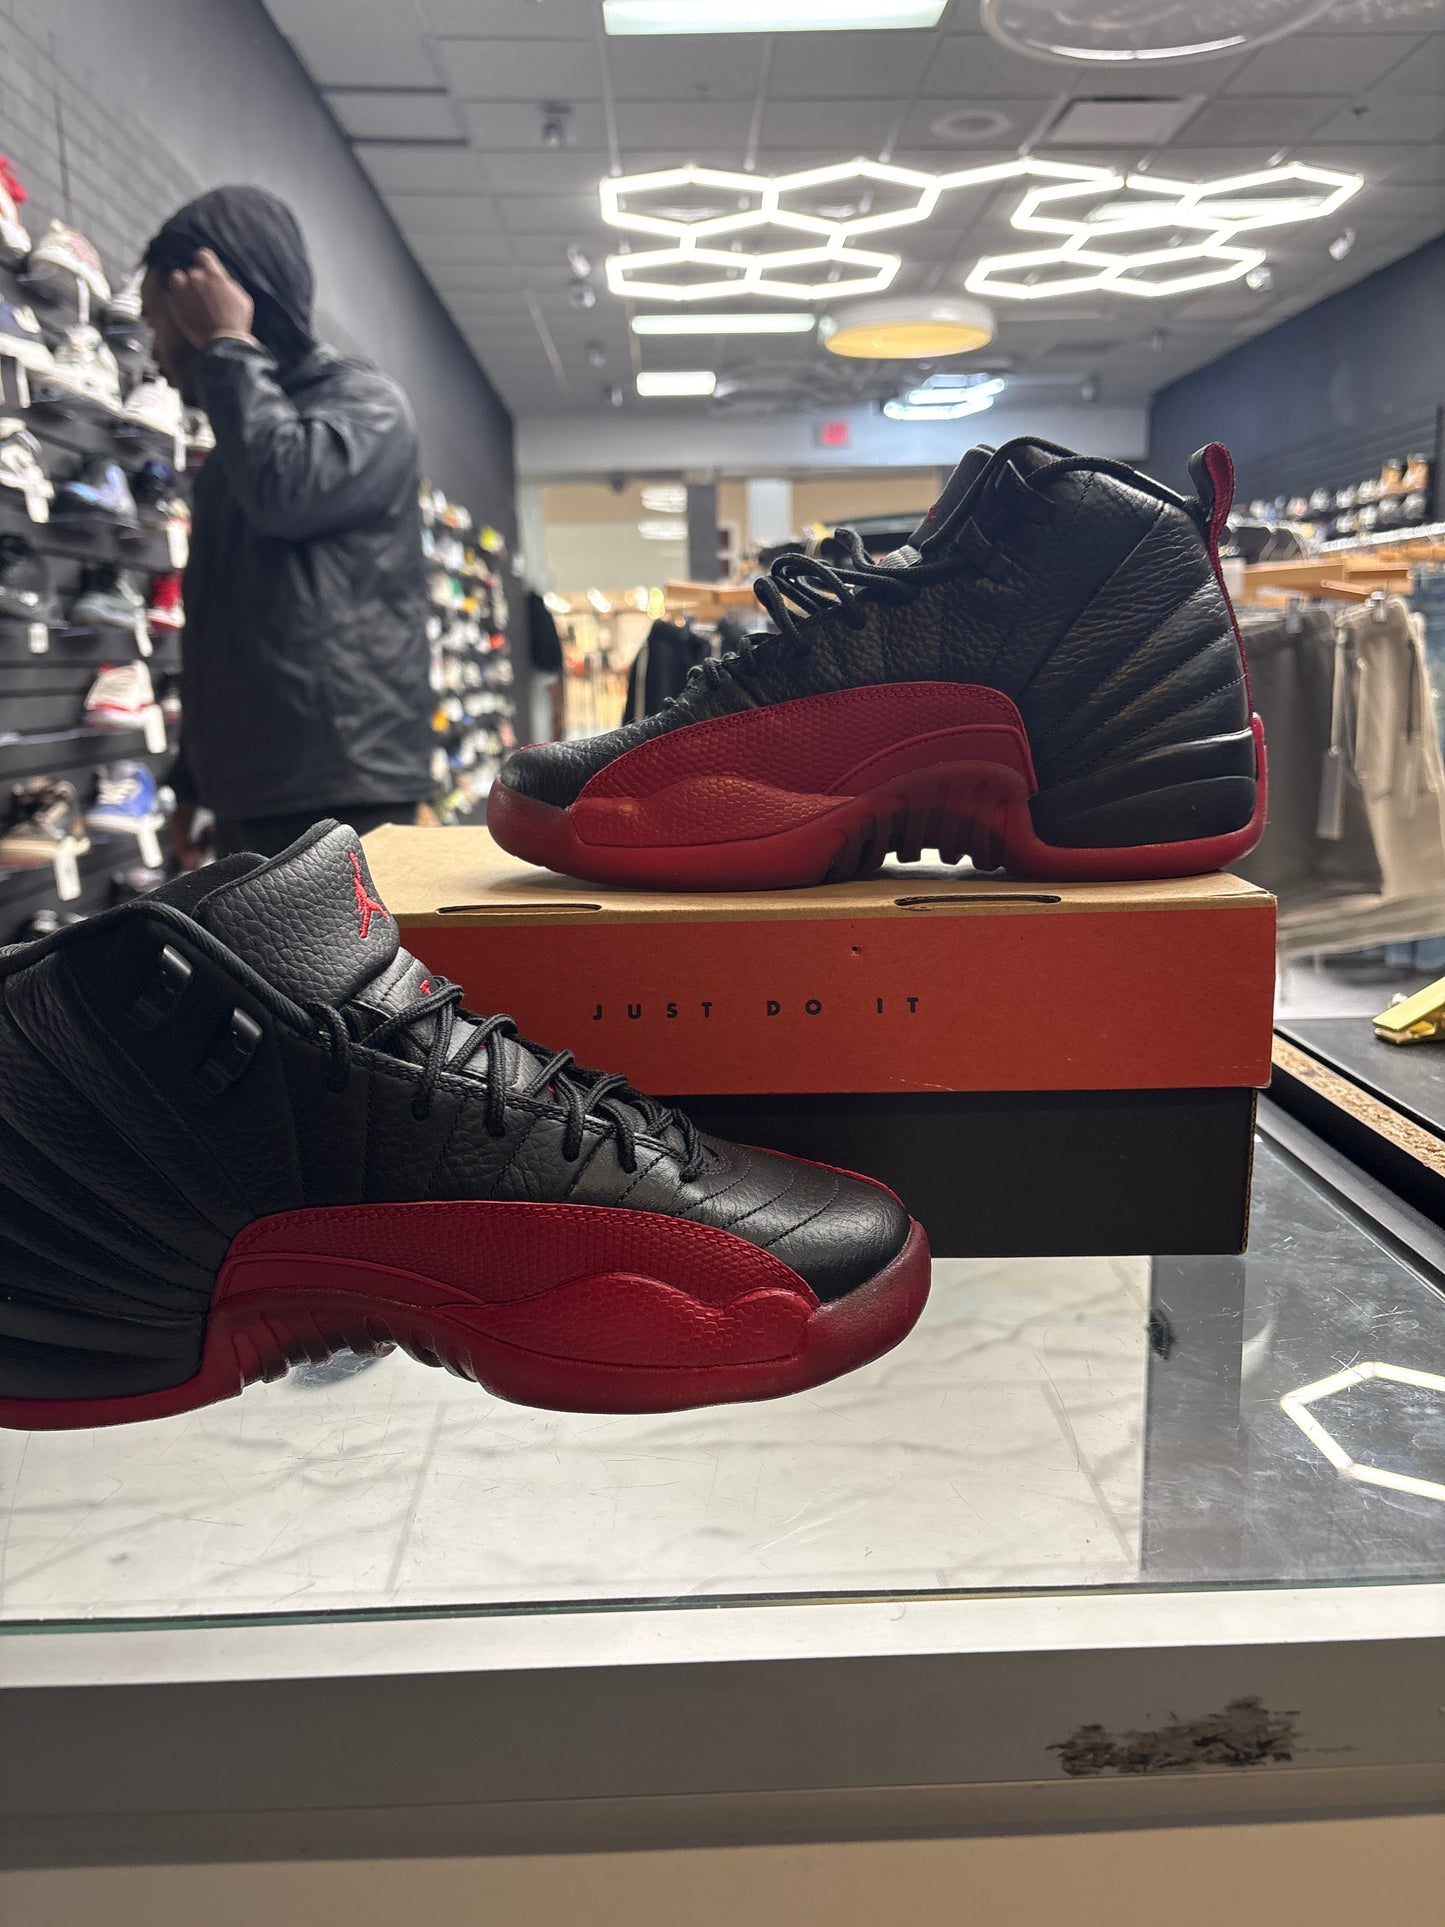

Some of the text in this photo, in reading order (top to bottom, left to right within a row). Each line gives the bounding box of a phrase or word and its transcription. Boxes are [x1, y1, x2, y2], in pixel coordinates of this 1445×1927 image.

[592, 997, 919, 1020] JUST DO IT
